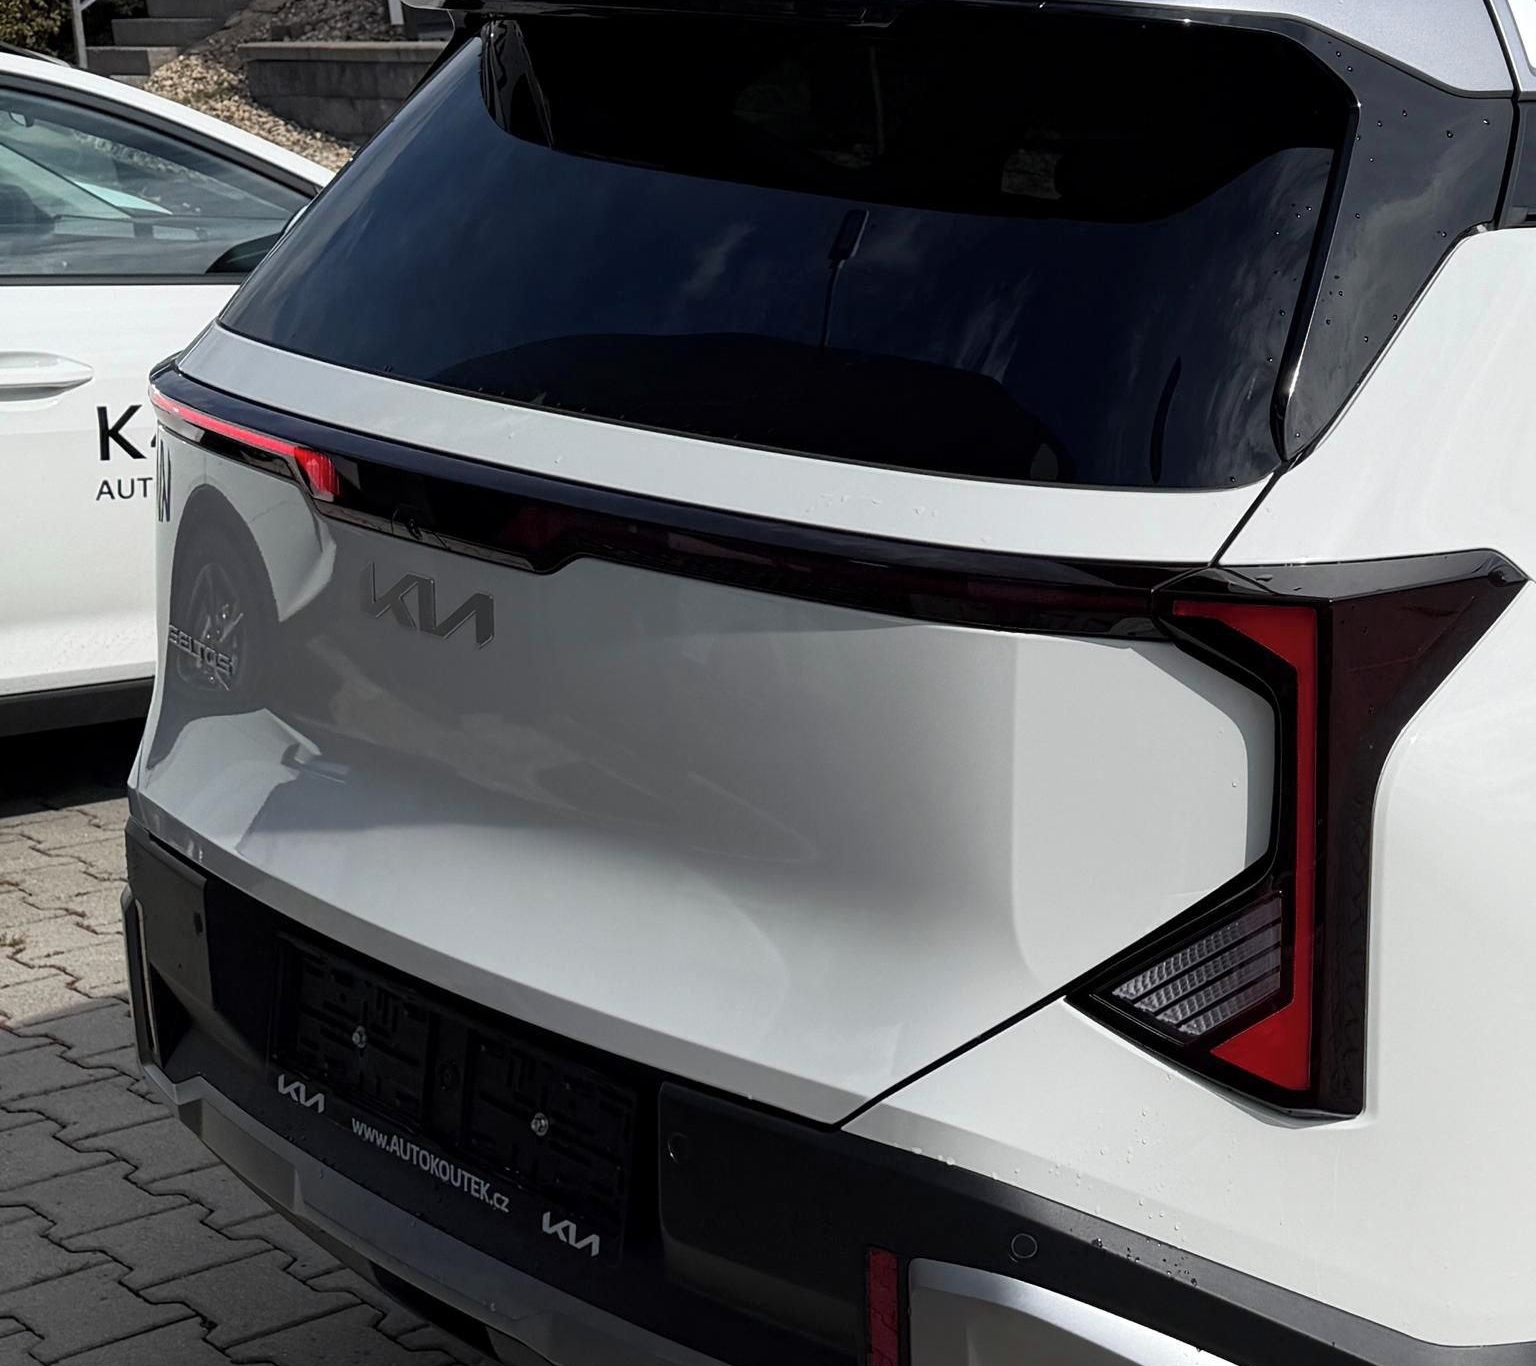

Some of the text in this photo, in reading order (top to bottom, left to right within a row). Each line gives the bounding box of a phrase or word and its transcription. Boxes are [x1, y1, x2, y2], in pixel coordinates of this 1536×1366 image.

[96, 404, 156, 461] K
[96, 477, 153, 501] AUT
[360, 562, 495, 651] KIA
[277, 1073, 326, 1115] KIA
[351, 1116, 512, 1215] www.AUTOKOUTEK.cz
[541, 1210, 600, 1258] KIA
